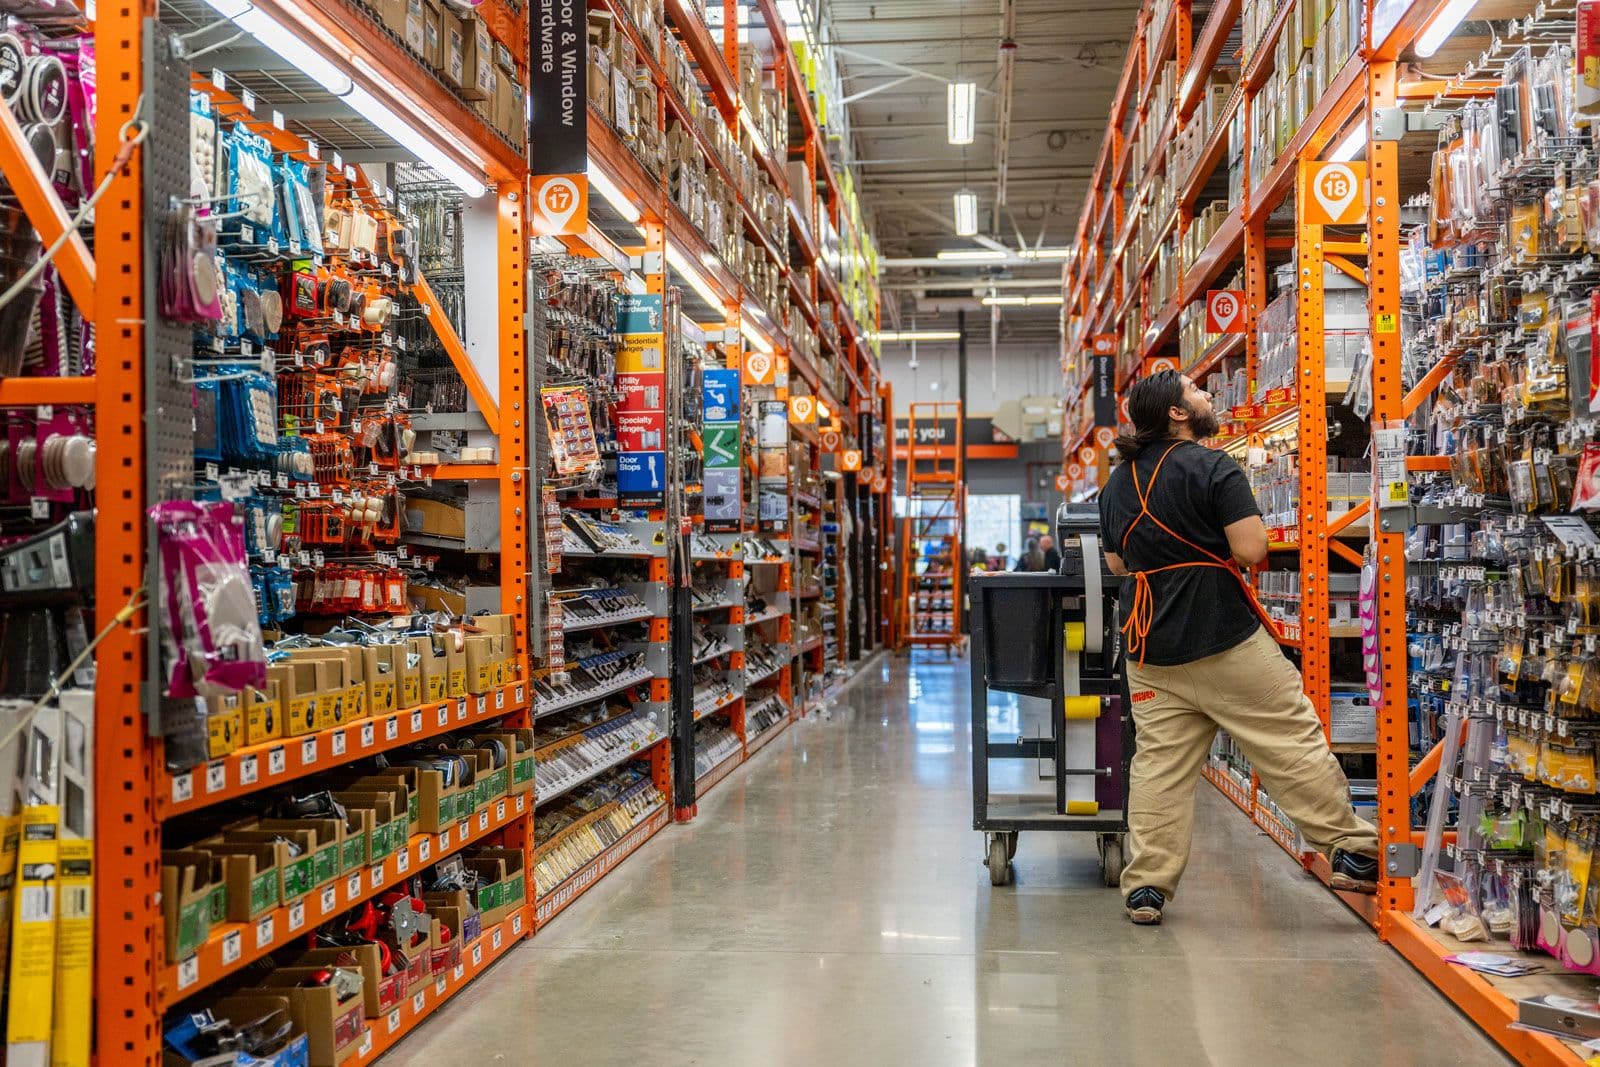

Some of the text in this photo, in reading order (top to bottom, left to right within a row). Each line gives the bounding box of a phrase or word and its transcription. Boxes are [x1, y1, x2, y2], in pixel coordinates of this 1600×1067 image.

[561, 32, 576, 46] &
[561, 49, 577, 126] Window
[1324, 180, 1348, 197] 18
[549, 193, 570, 209] 17
[1217, 303, 1232, 315] 16
[619, 337, 658, 345] esidential
[1100, 357, 1108, 374] Door
[619, 377, 640, 385] Utility
[619, 416, 653, 425] Specialty
[619, 425, 645, 433] Hinges
[920, 427, 946, 442] you
[619, 456, 638, 464] Door
[619, 463, 641, 472] Stops
